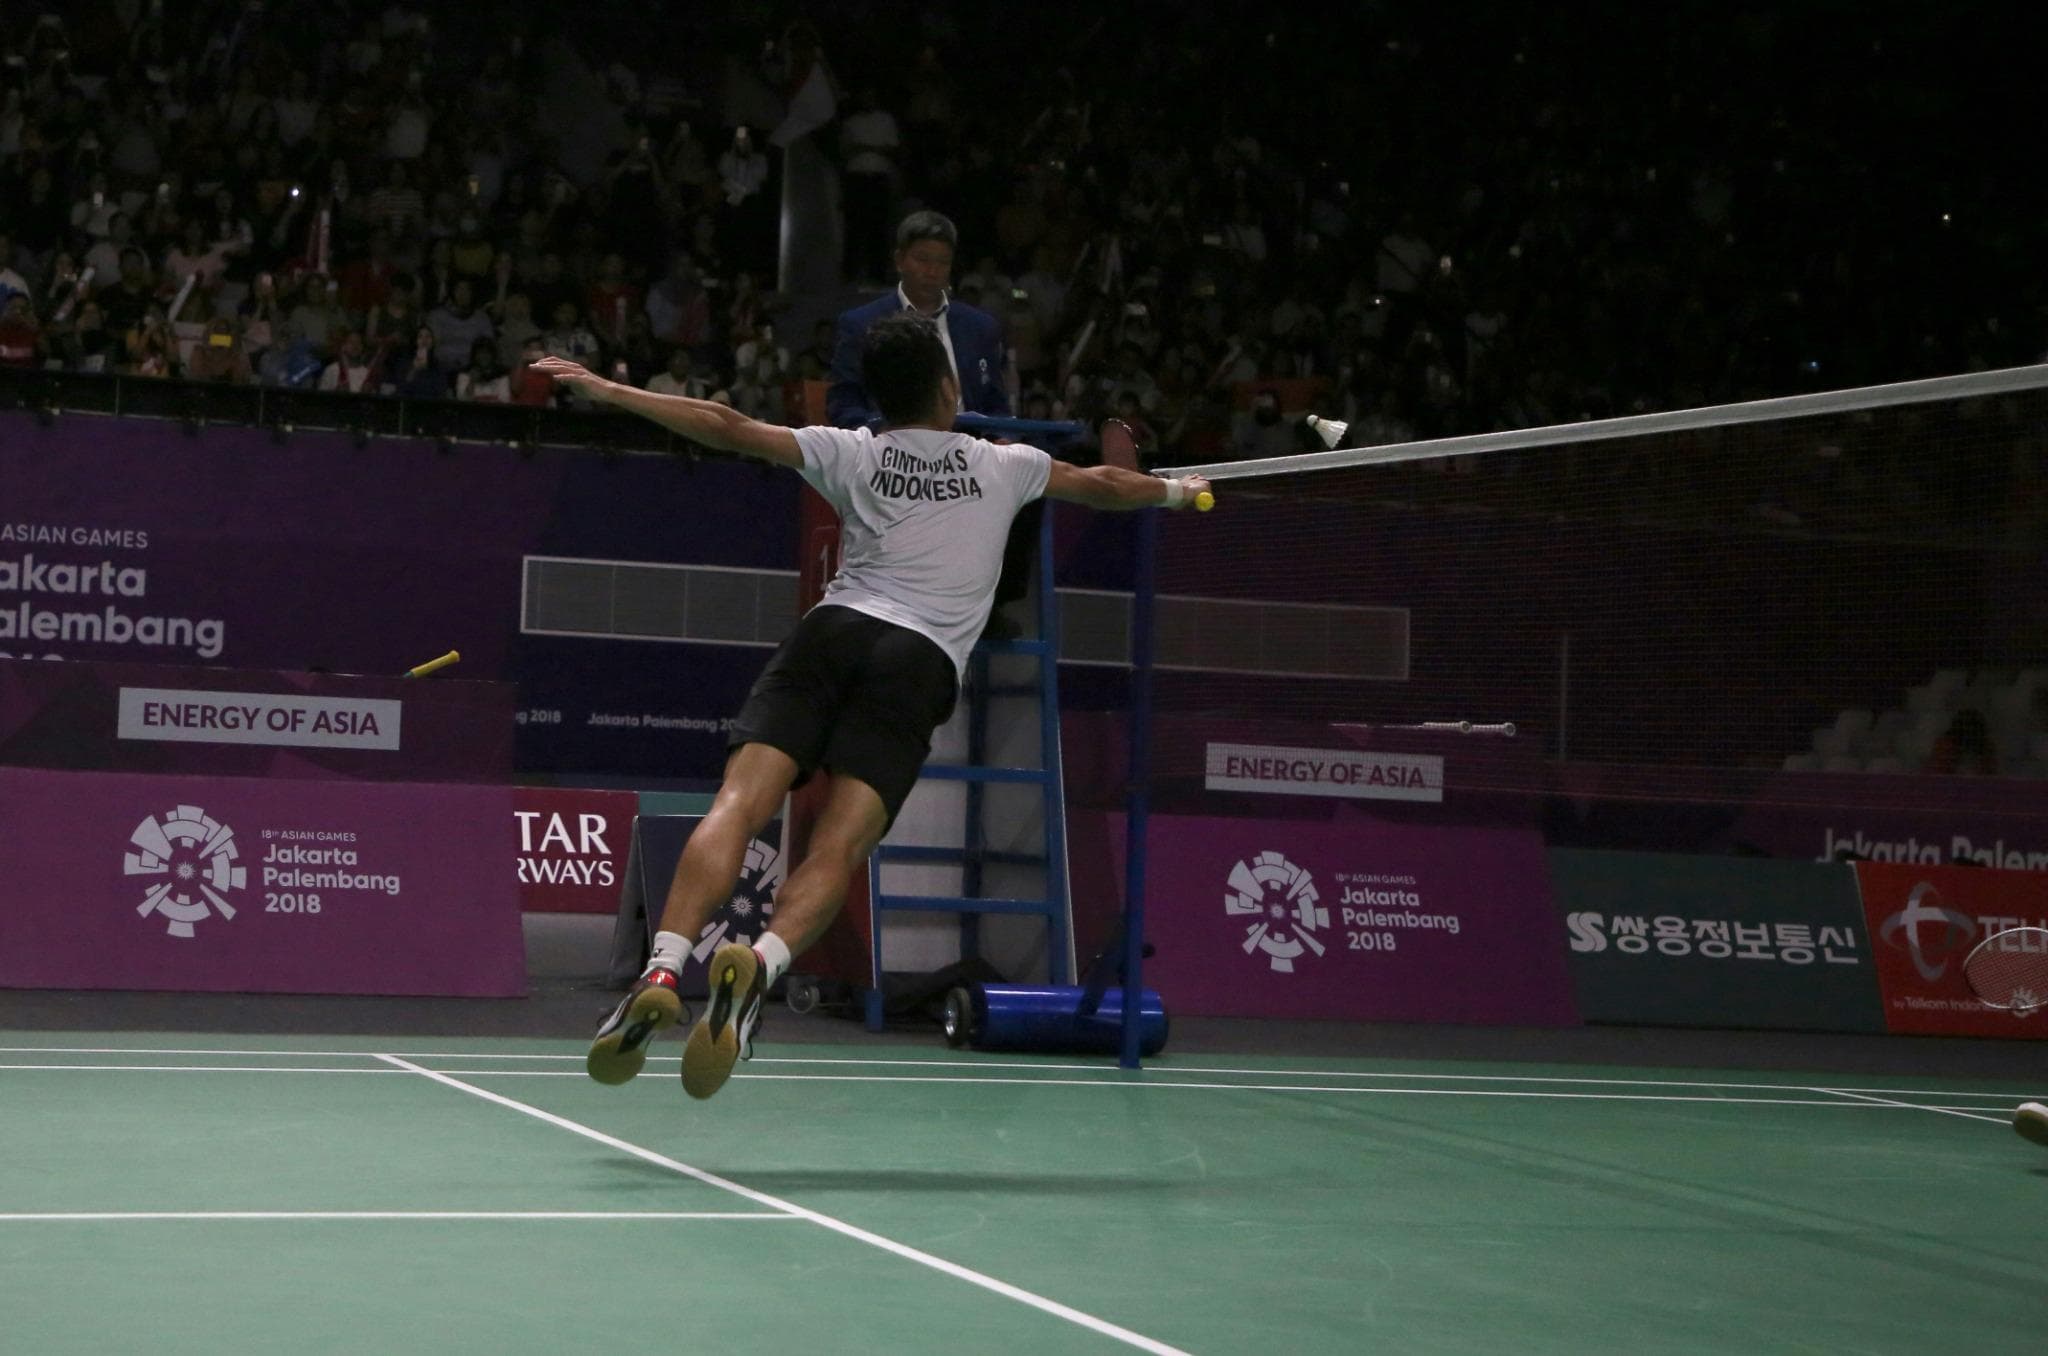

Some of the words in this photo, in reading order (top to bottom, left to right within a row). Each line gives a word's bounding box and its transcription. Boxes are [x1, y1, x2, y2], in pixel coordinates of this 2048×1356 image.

[870, 470, 982, 501] INDONESIA
[0, 524, 67, 544] ASIAN
[71, 527, 149, 549] GAMES
[0, 552, 147, 597] akarta
[143, 702, 260, 730] ENERGY
[266, 708, 306, 732] OF
[312, 710, 379, 736] ASIA
[530, 708, 562, 724] 2018
[587, 713, 640, 727] Jakarta
[642, 715, 718, 733] Palembang
[1226, 756, 1324, 782] ENERGY
[1330, 763, 1363, 785] OF
[1368, 765, 1425, 788] ASIA
[281, 831, 315, 840] ASIAN
[316, 832, 357, 842] GAMES
[514, 811, 612, 855] TAR
[262, 843, 358, 866] Jakarta
[263, 867, 401, 896] Palembang
[1352, 874, 1380, 884] ASIAN
[264, 893, 322, 914] 2018
[1340, 886, 1420, 907] Jakarta
[1342, 907, 1460, 934] Palembang
[1347, 932, 1397, 951] 2018
[1610, 915, 1859, 965] 쌍용정보통신
[1904, 996, 1949, 1009] Telkom
